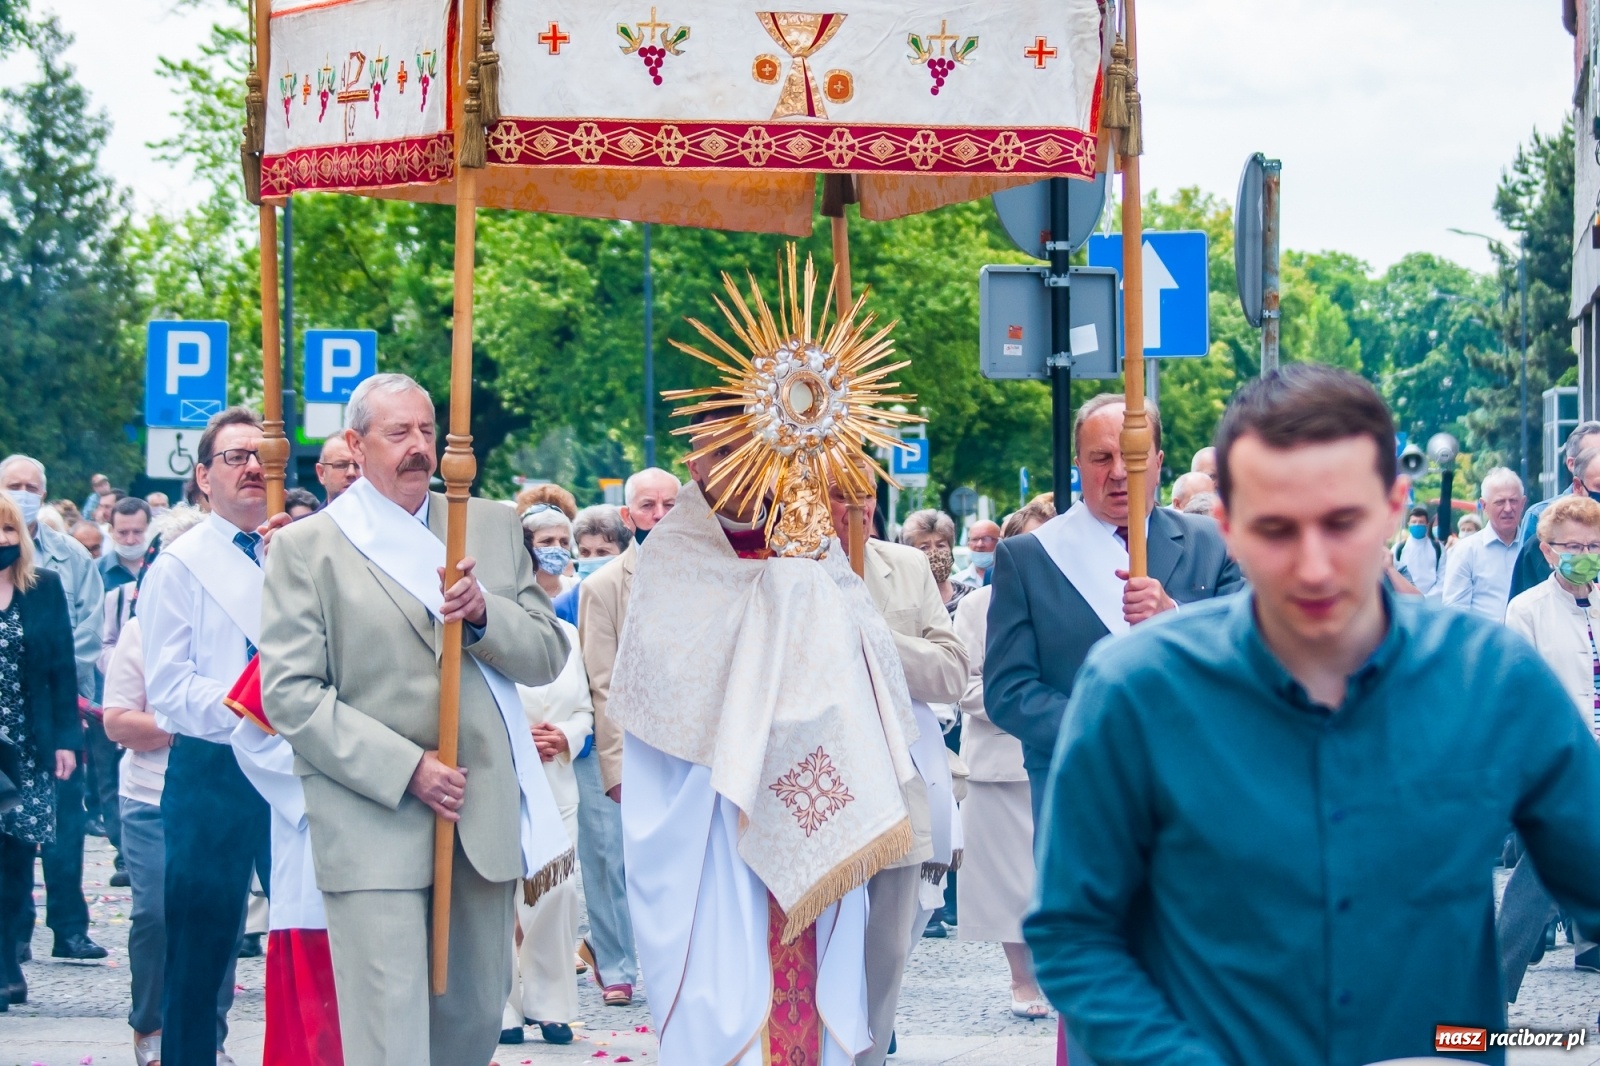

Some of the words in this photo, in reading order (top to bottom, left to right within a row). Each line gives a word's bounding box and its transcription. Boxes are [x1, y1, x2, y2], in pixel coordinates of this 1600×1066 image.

[165, 330, 211, 395] P
[321, 338, 362, 393] P
[901, 442, 921, 469] P
